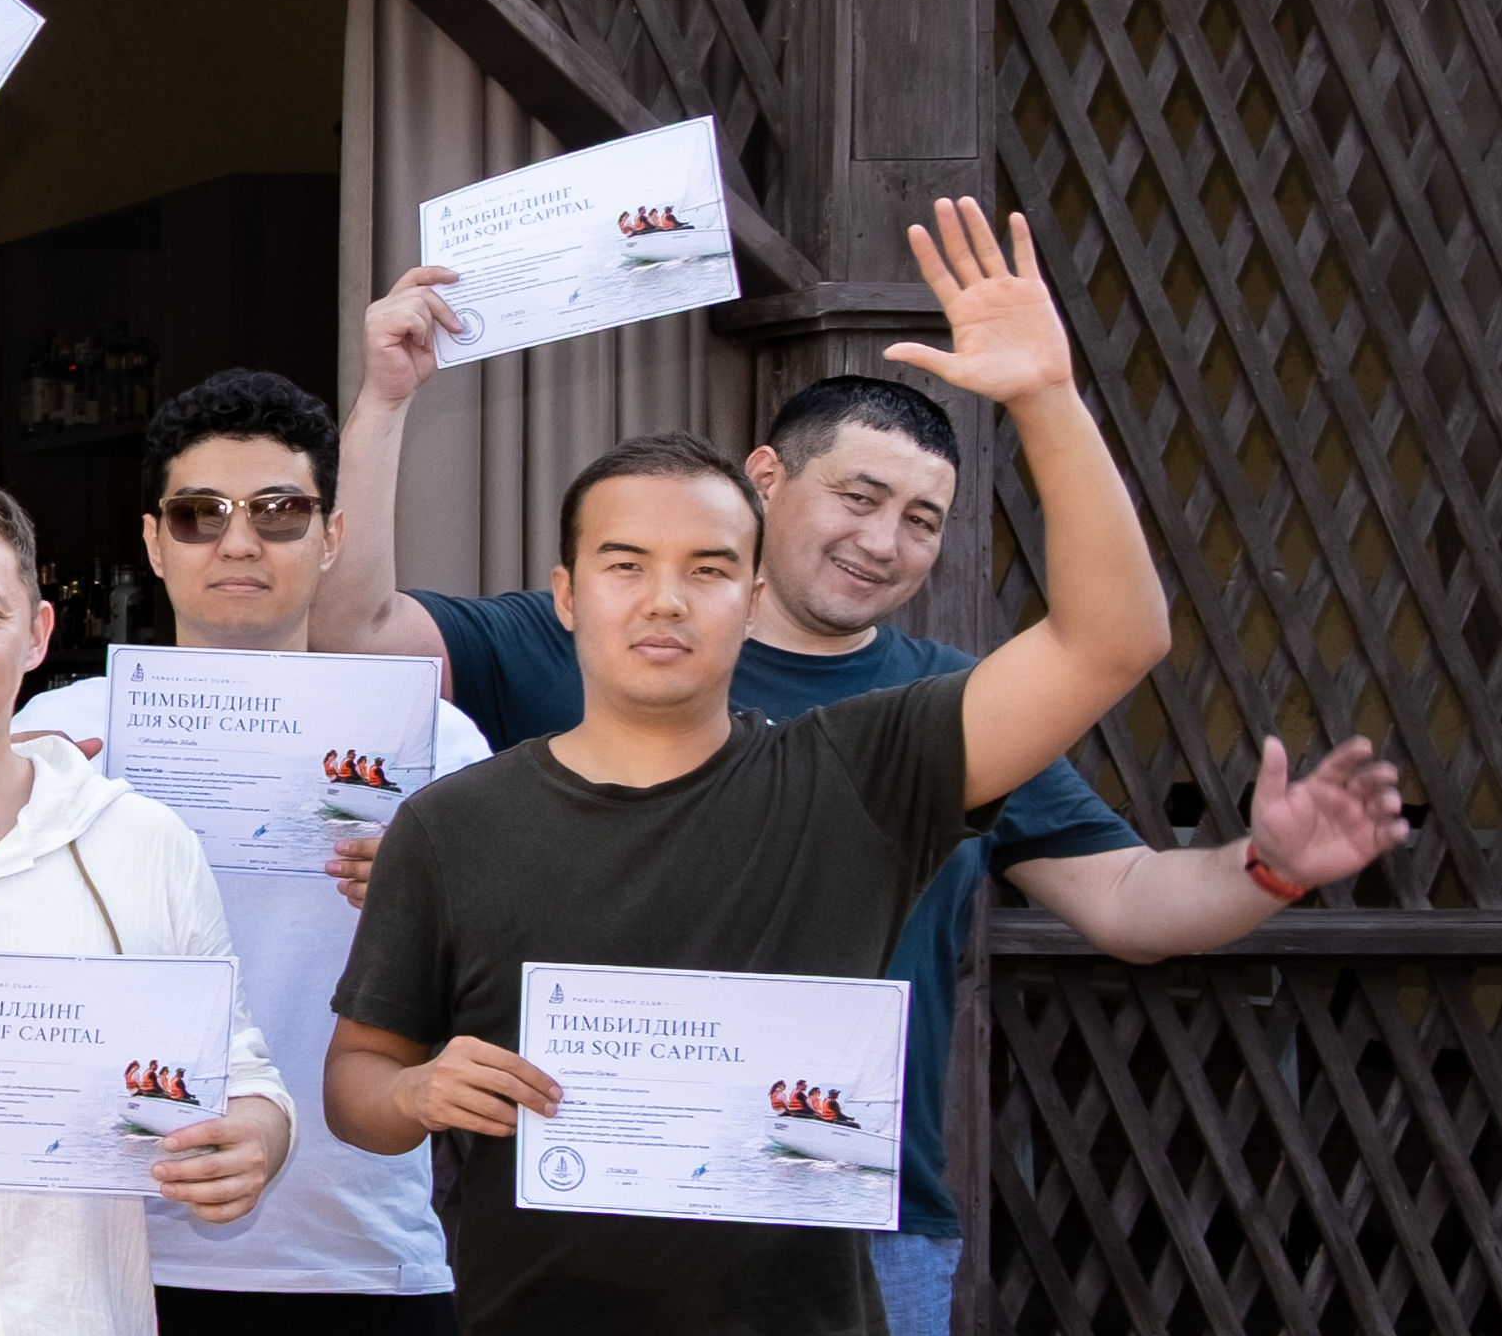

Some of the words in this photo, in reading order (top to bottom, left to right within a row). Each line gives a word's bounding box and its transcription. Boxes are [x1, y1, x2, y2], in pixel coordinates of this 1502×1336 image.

[439, 186, 573, 237] ТИМБИЛДИНГ
[439, 233, 470, 251] ДЛЯ
[474, 220, 513, 242] SQIF
[520, 198, 595, 227] CAPITAL
[128, 690, 281, 713] ТИМБИЛДИНГ
[126, 713, 162, 728] ДЛЯ
[168, 714, 213, 732] SQIF
[220, 717, 303, 734] CAPITAL
[19, 1026, 105, 1044] CAPITAL
[546, 1013, 722, 1038] ТИМБИЛДИНГ
[544, 1039, 585, 1056] ДЛЯ
[591, 1040, 642, 1058] SQIF
[650, 1042, 745, 1063] CAPITAL
